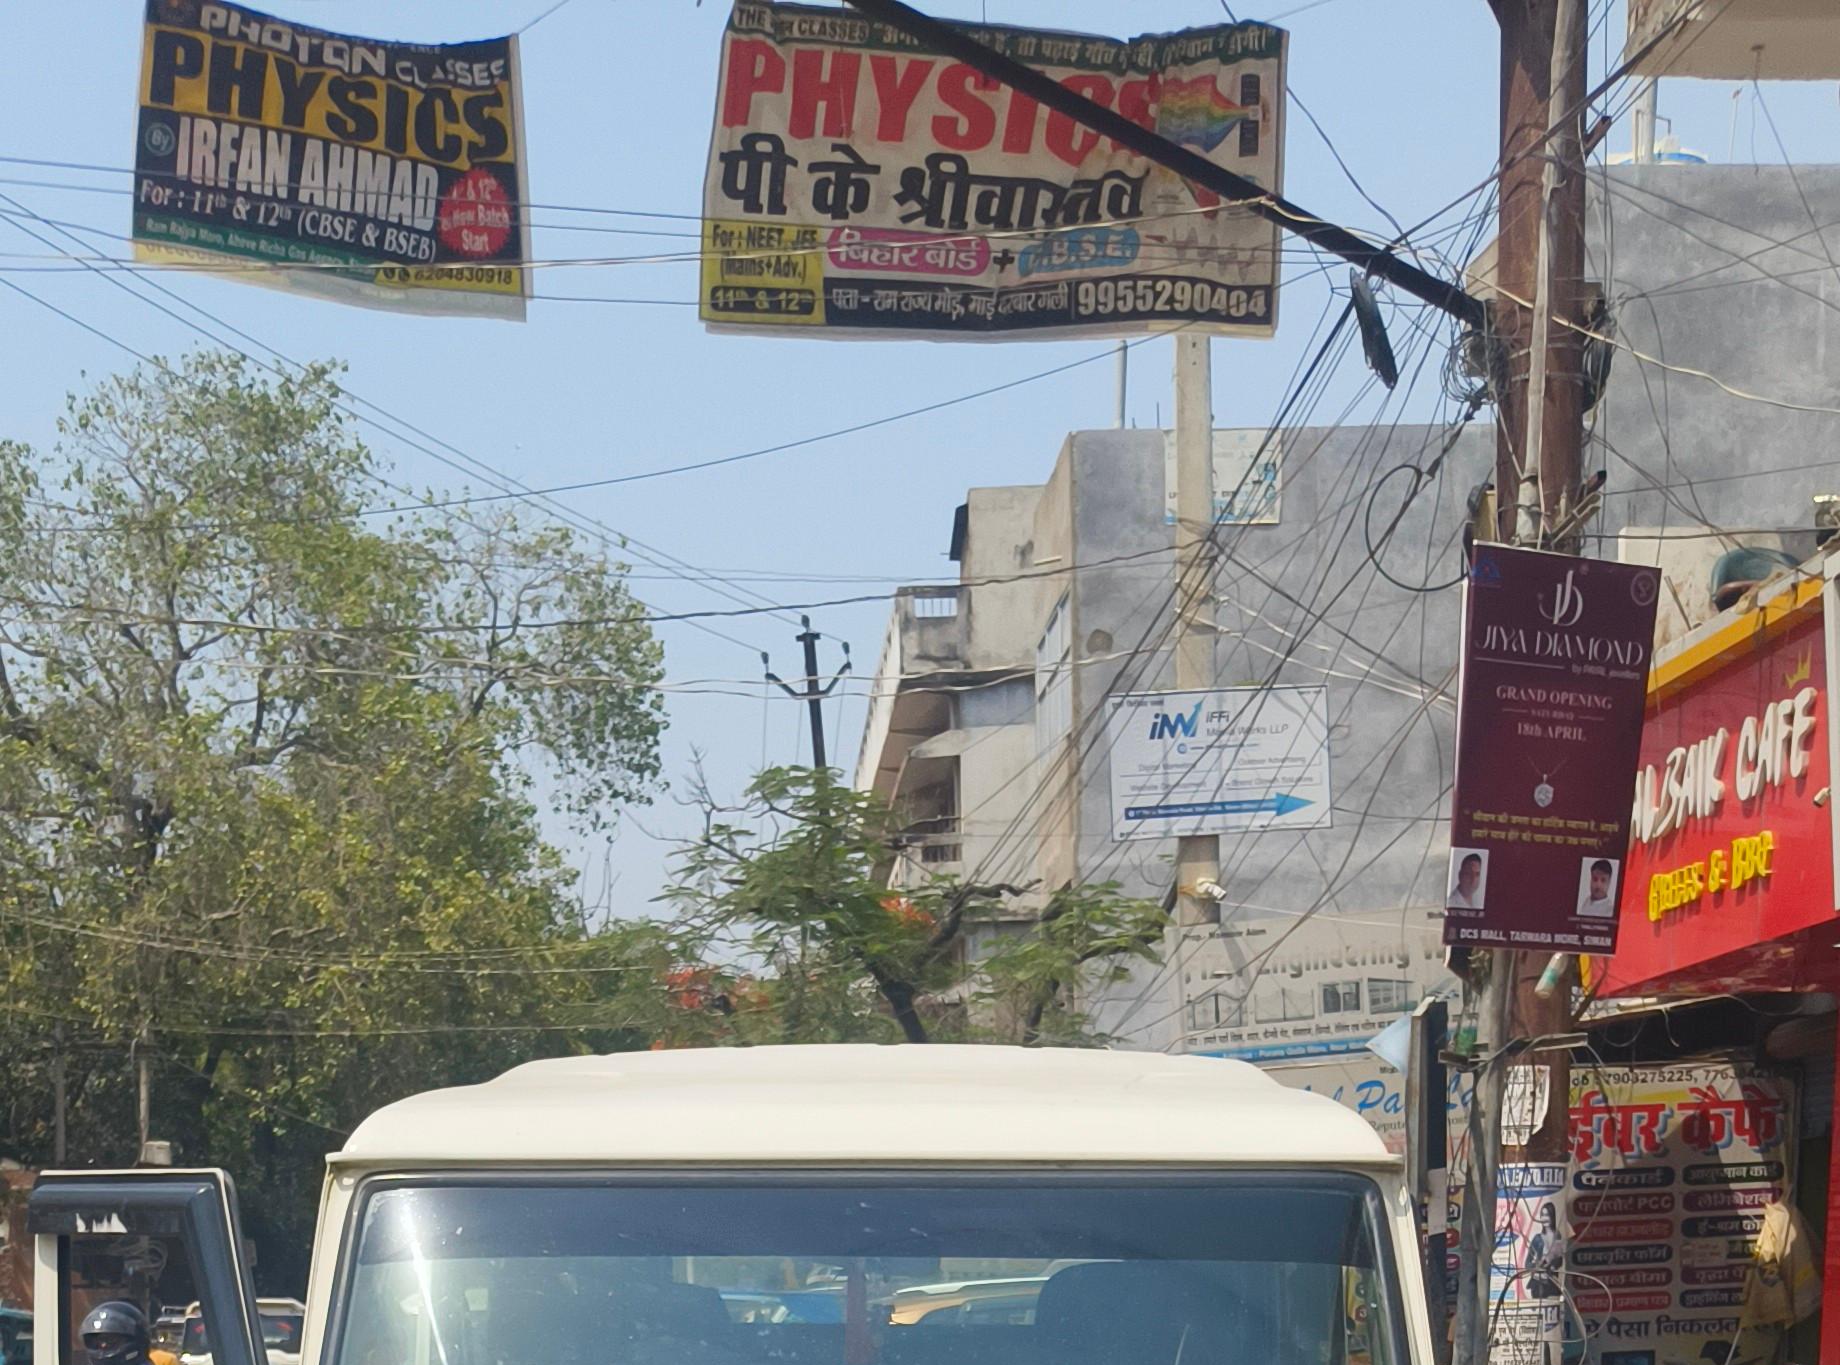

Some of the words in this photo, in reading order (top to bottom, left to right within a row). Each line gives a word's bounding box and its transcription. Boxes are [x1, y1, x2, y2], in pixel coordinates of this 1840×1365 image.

[737, 8, 767, 27] THE
[798, 16, 869, 42] CLASSES
[200, 4, 387, 77] PHOTON
[395, 58, 505, 90] CLASSES
[149, 29, 509, 164] PHYSICS
[151, 129, 169, 151] By
[176, 115, 292, 200] IRFAN
[299, 139, 440, 233] AHMAD
[719, 132, 798, 216] पी
[806, 144, 881, 221] के
[892, 152, 1151, 234] श्रीवास्तव
[140, 178, 173, 206] For
[192, 190, 227, 216] 11th
[232, 195, 250, 221] &
[257, 202, 292, 227] 12th
[297, 207, 358, 244] (CBSE
[361, 222, 380, 248] &
[383, 226, 437, 263] BSEB)
[712, 224, 736, 248] For
[461, 228, 489, 252] Start
[837, 227, 918, 266] बिहार
[924, 236, 979, 271] बोर्ड
[754, 290, 772, 311] &
[1077, 279, 1267, 318] 9955290404
[1475, 624, 1527, 654] JIYA
[1534, 630, 1644, 667] DIAMOND
[1496, 684, 1547, 702] GRAND
[1549, 691, 1613, 710] OPENING
[1269, 724, 1289, 735] LLP
[1517, 721, 1543, 737] 18th
[1547, 726, 1588, 743] APRIL
[1735, 686, 1817, 801] CAFE
[1637, 1197, 1673, 1212] PCC
[1607, 1314, 1649, 1339] पैसा
